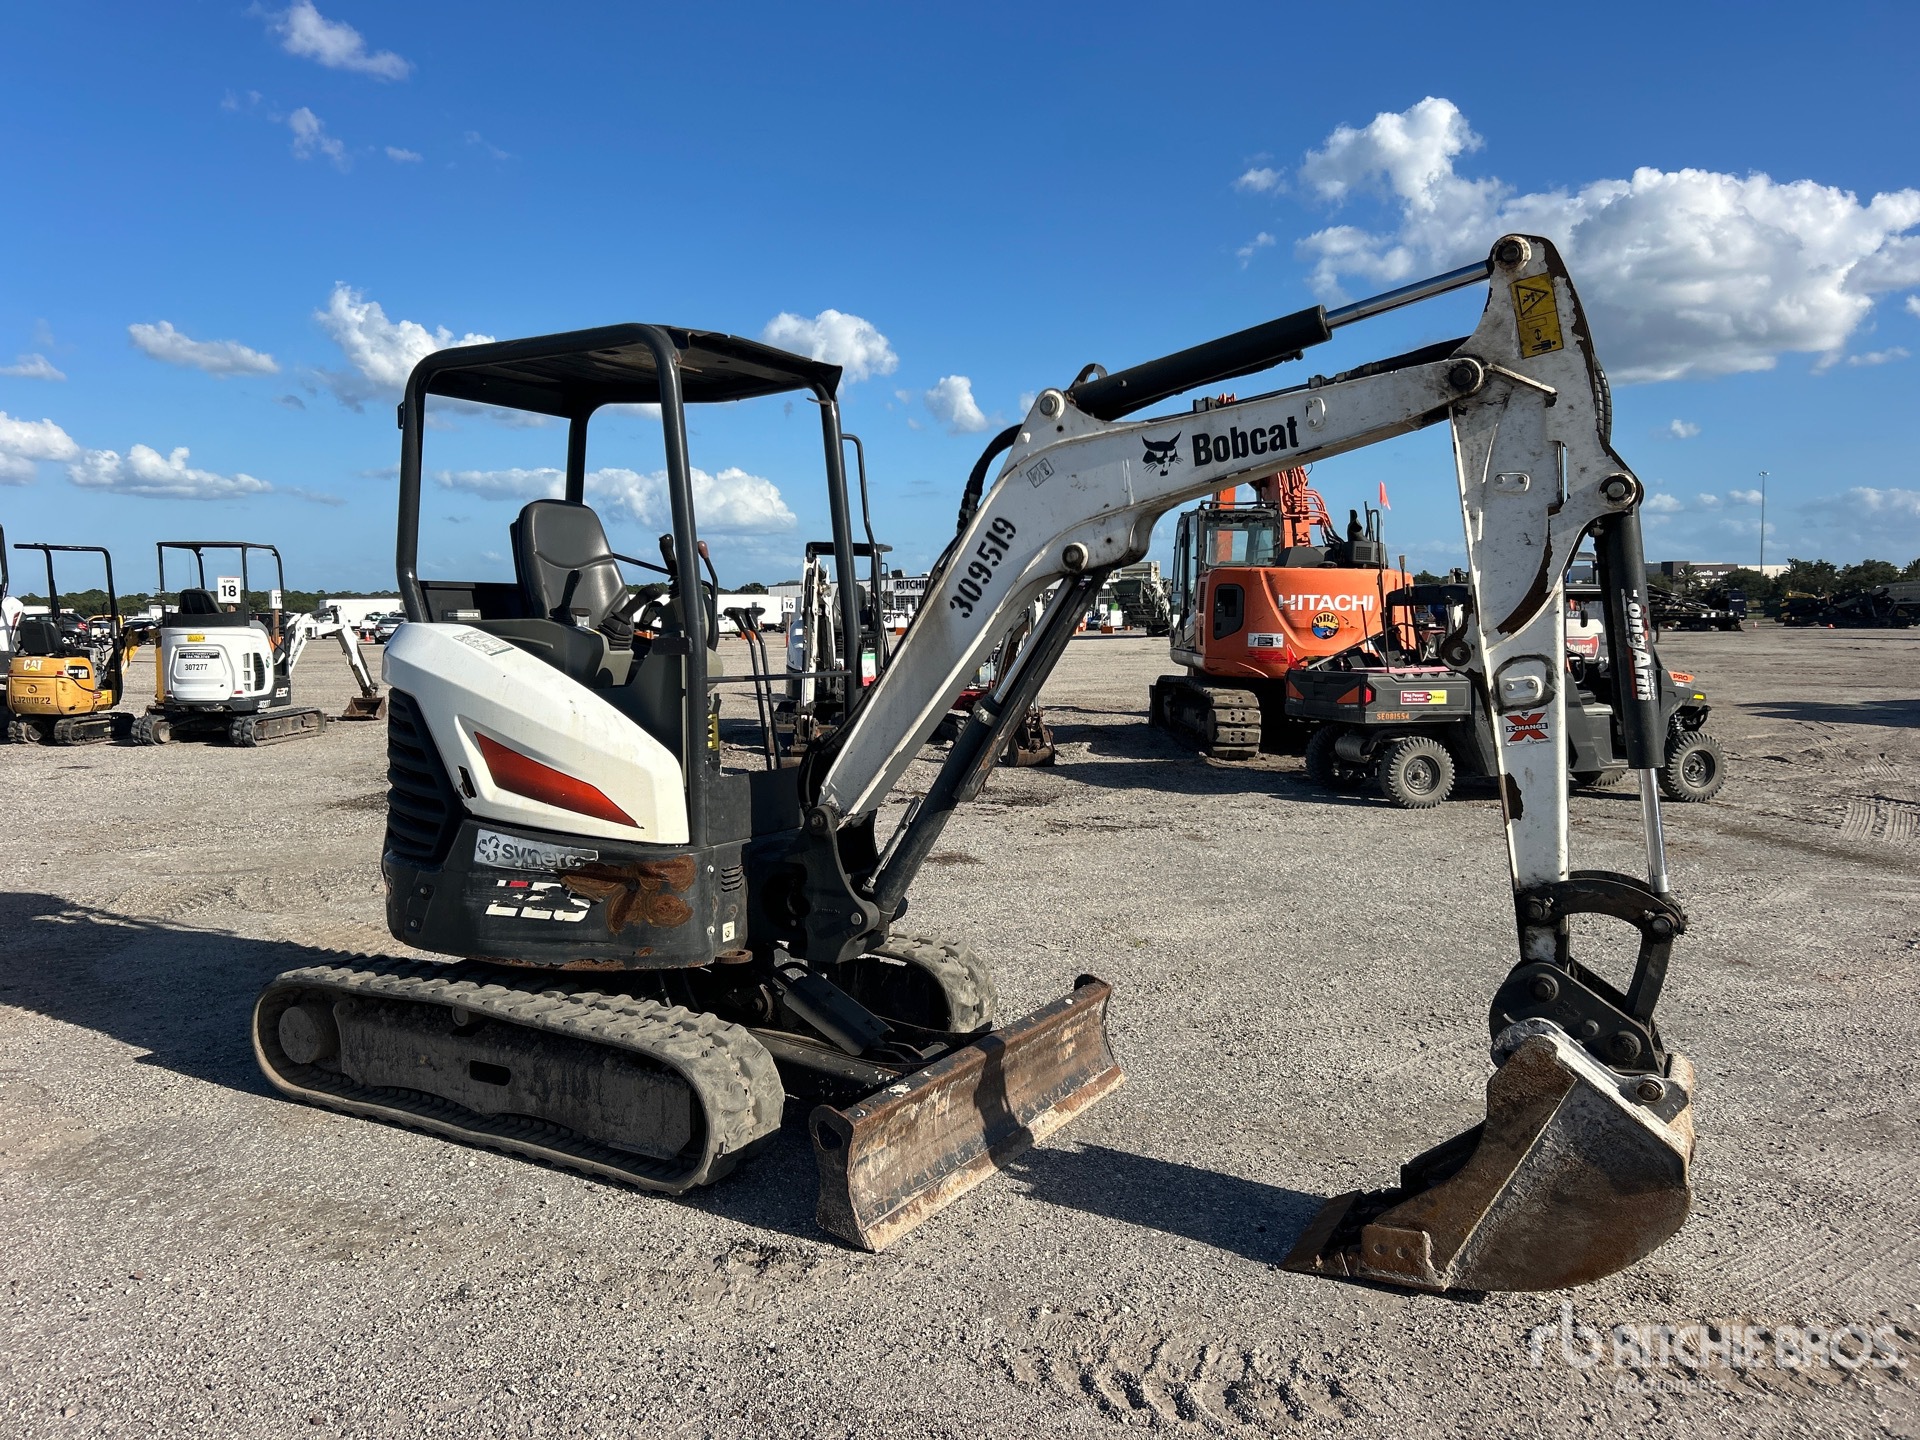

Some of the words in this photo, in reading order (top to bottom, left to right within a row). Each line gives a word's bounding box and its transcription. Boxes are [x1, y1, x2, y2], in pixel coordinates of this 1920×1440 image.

[1192, 416, 1299, 467] Bobcat
[949, 517, 1017, 619] 309519
[896, 580, 926, 590] RITCHI
[221, 585, 237, 597] 18
[785, 601, 794, 609] 16
[1279, 594, 1374, 611] HITACHI
[23, 660, 44, 671] CAT
[184, 663, 208, 671] 307277
[1673, 673, 1689, 681] PRO
[1507, 723, 1547, 732] X-CHANGE
